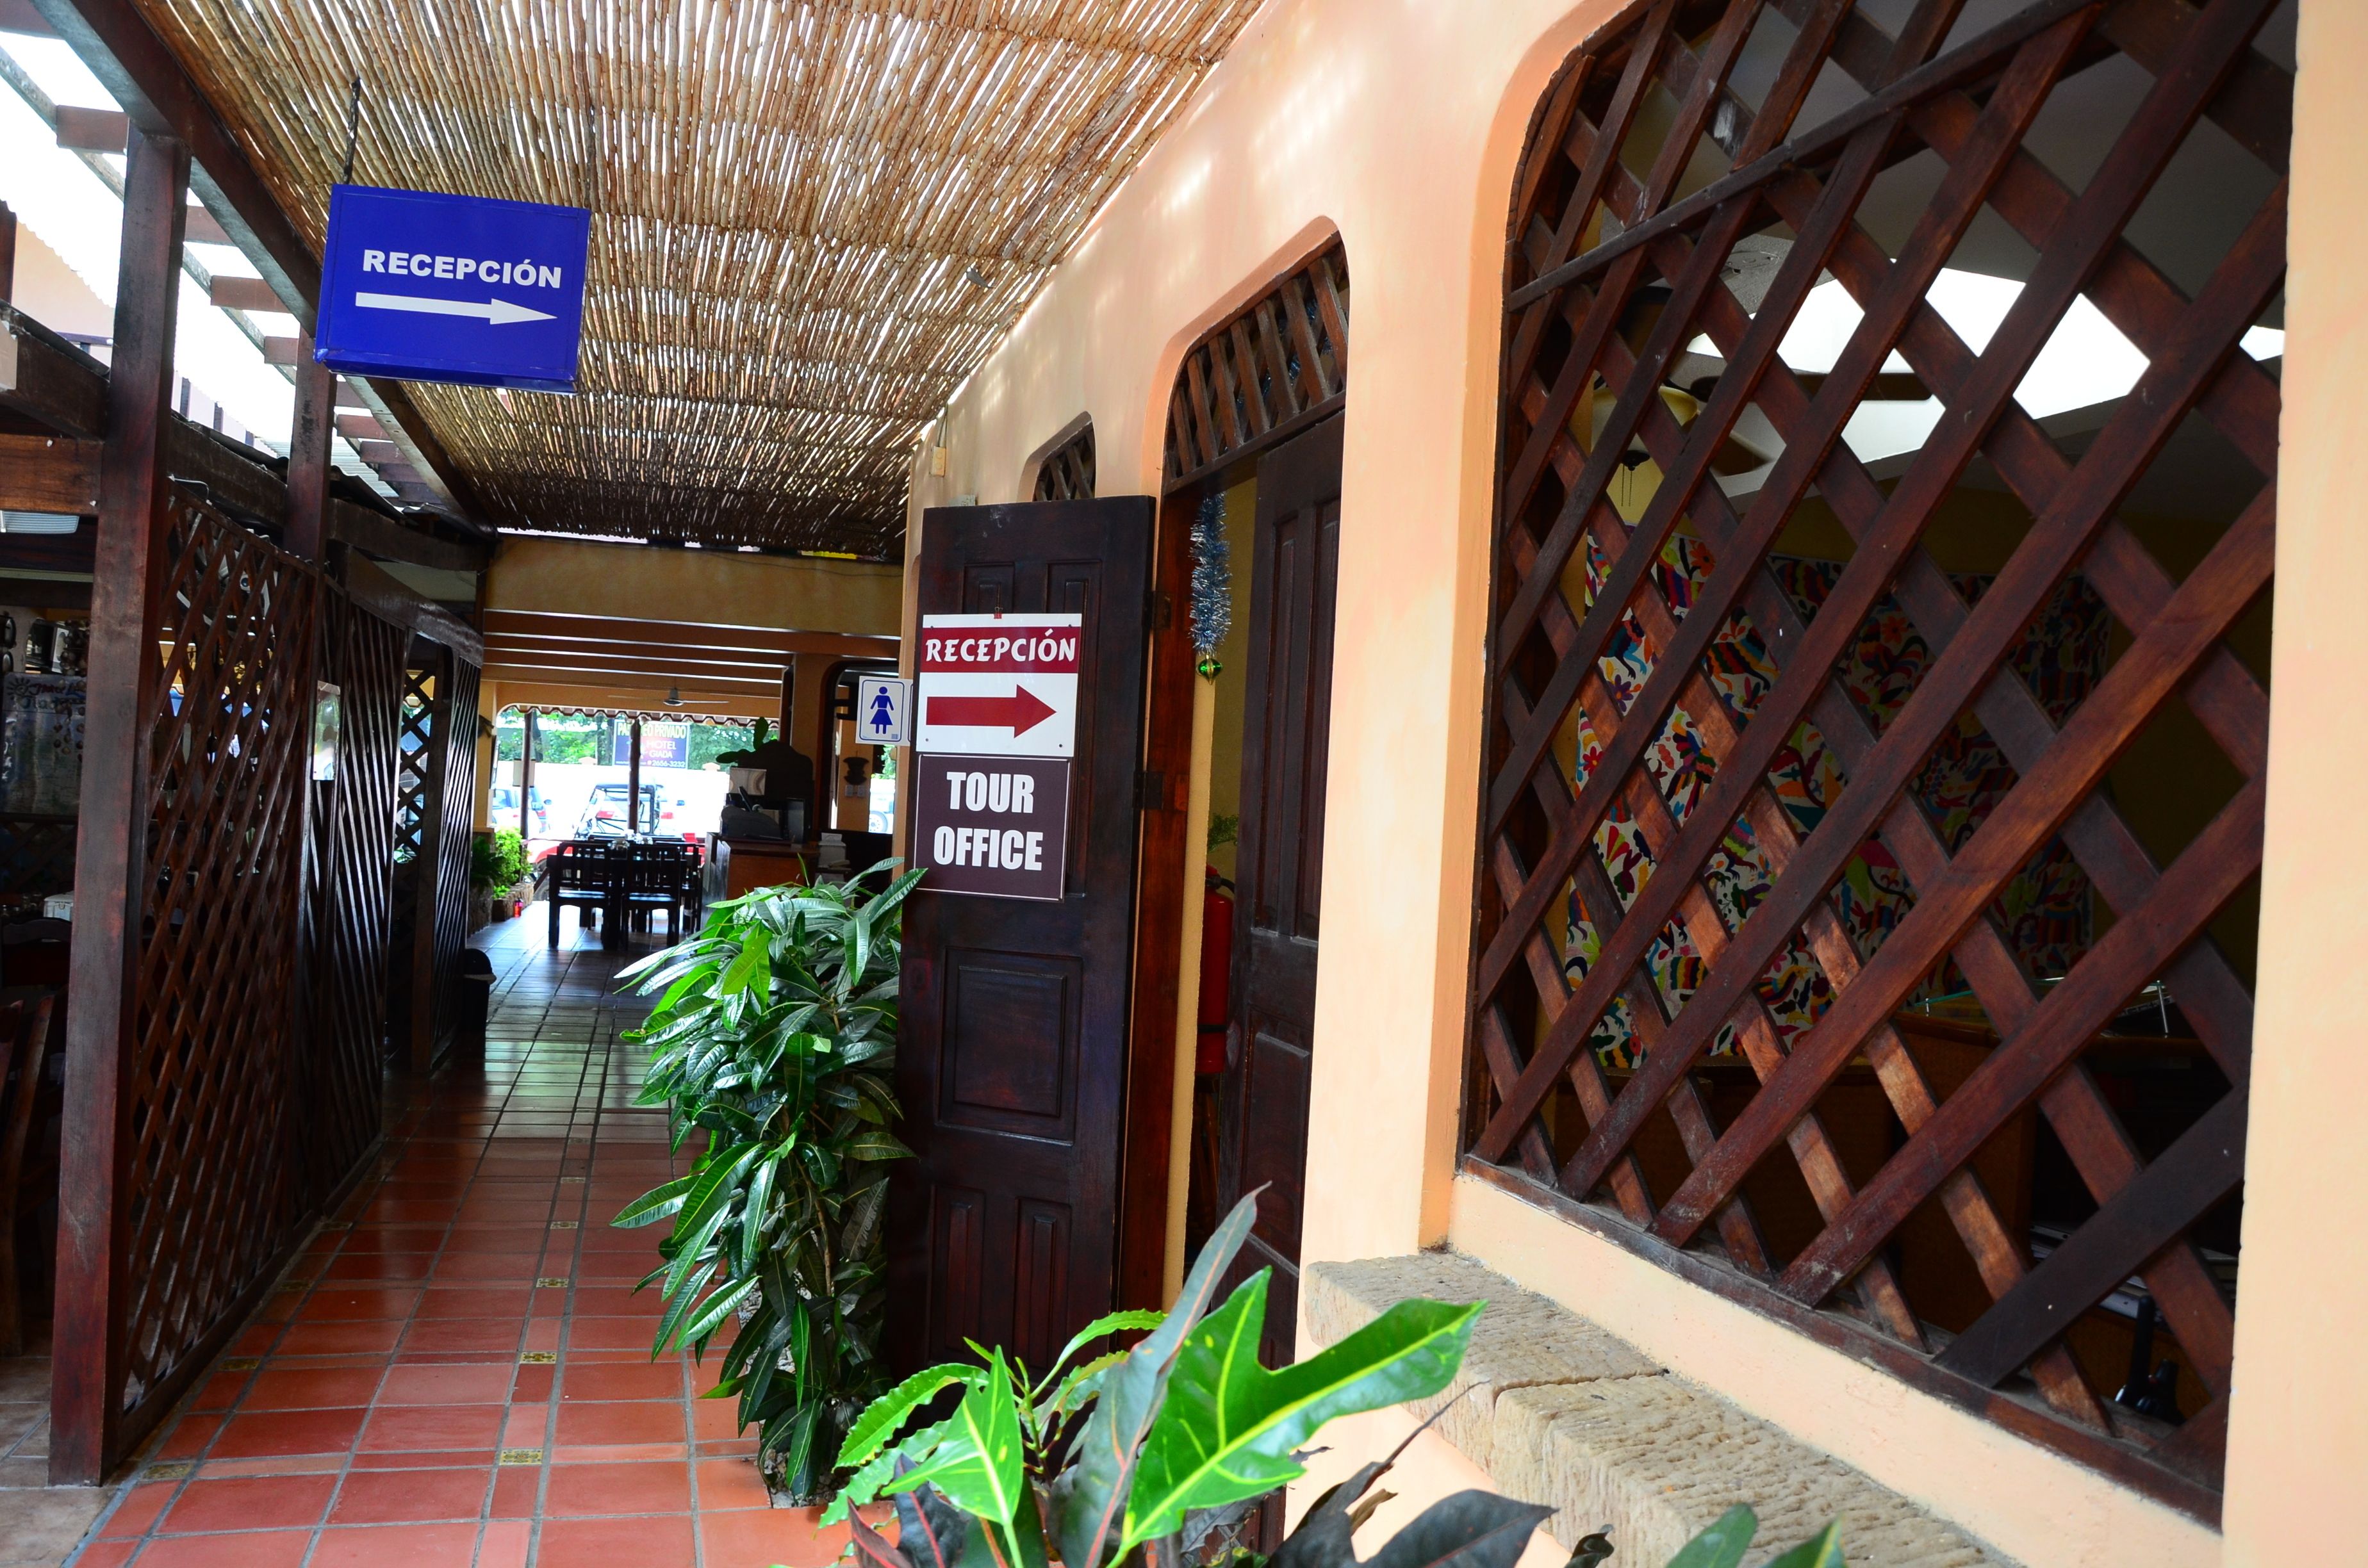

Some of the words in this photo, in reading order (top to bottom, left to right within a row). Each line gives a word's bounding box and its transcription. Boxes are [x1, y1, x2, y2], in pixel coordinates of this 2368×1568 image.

[363, 249, 562, 288] RECEPCIÓN
[925, 628, 1076, 662] RECEPCIÓN
[646, 740, 677, 750] HOTEL
[654, 724, 687, 739] PRIVADO
[649, 750, 673, 758] GIADA
[946, 771, 1035, 813] TOUR
[933, 826, 1044, 871] OFFICE
